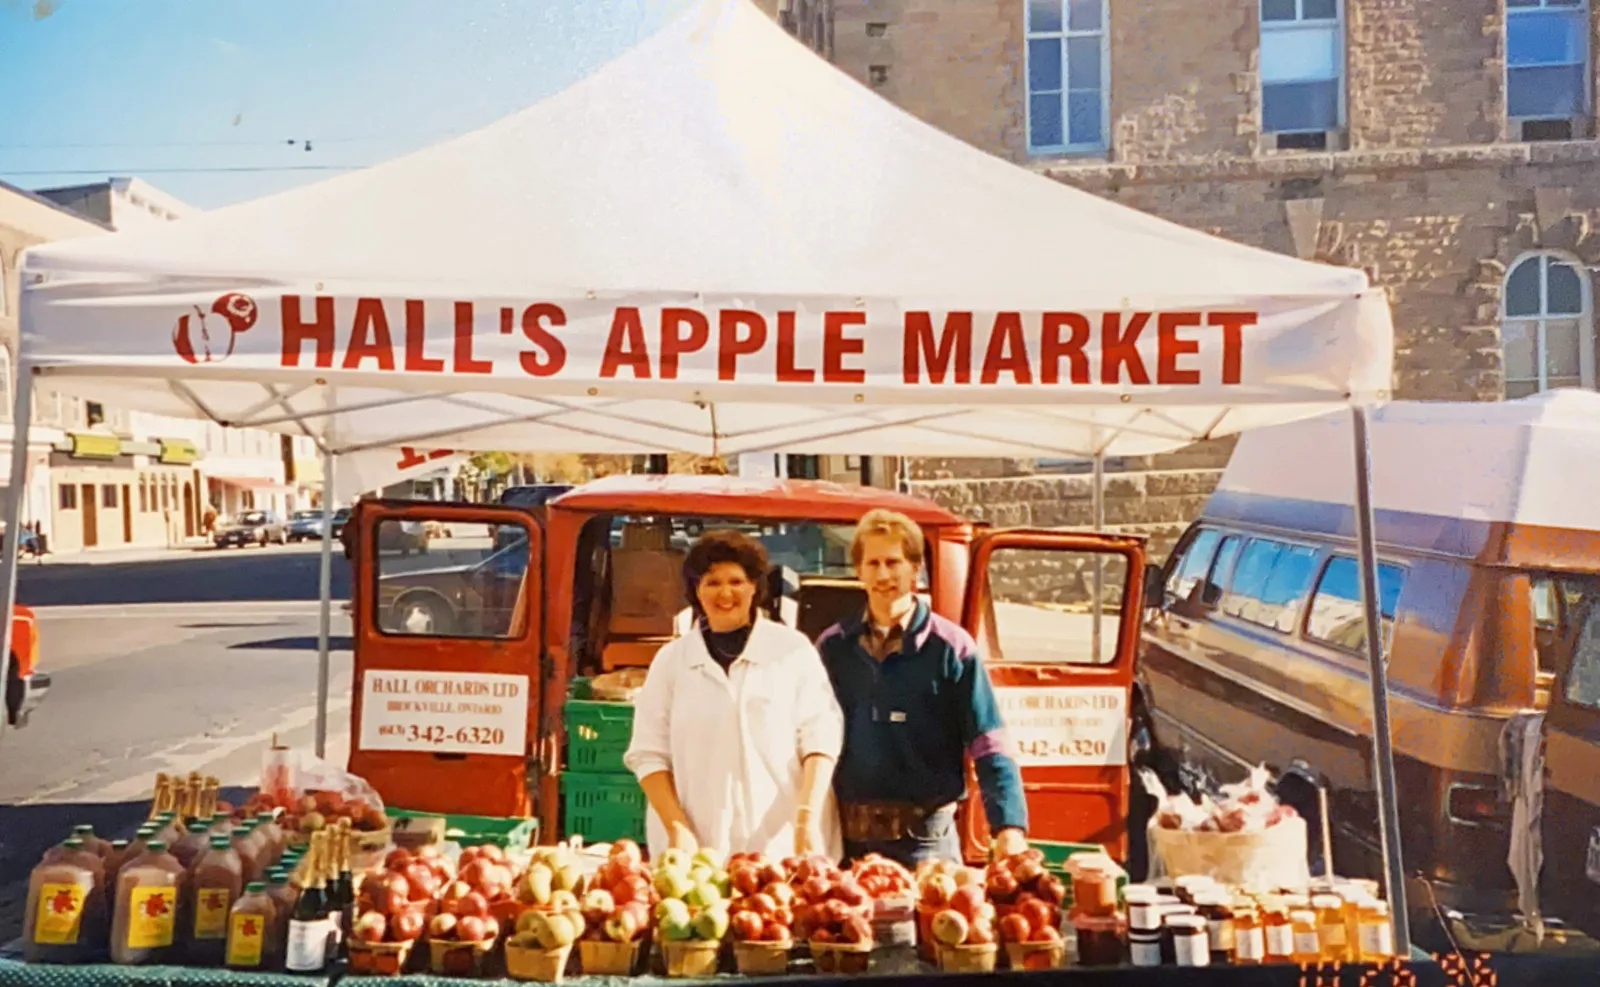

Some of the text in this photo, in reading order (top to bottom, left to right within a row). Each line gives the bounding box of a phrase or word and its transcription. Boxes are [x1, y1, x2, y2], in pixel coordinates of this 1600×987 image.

[279, 294, 1258, 385] HALL'S APPLE MARKET
[372, 677, 520, 698] HALL ORCHARDS LTD
[1092, 694, 1119, 710] LTD
[406, 724, 505, 746] 342-6320
[1017, 739, 1107, 757] 342-6320
